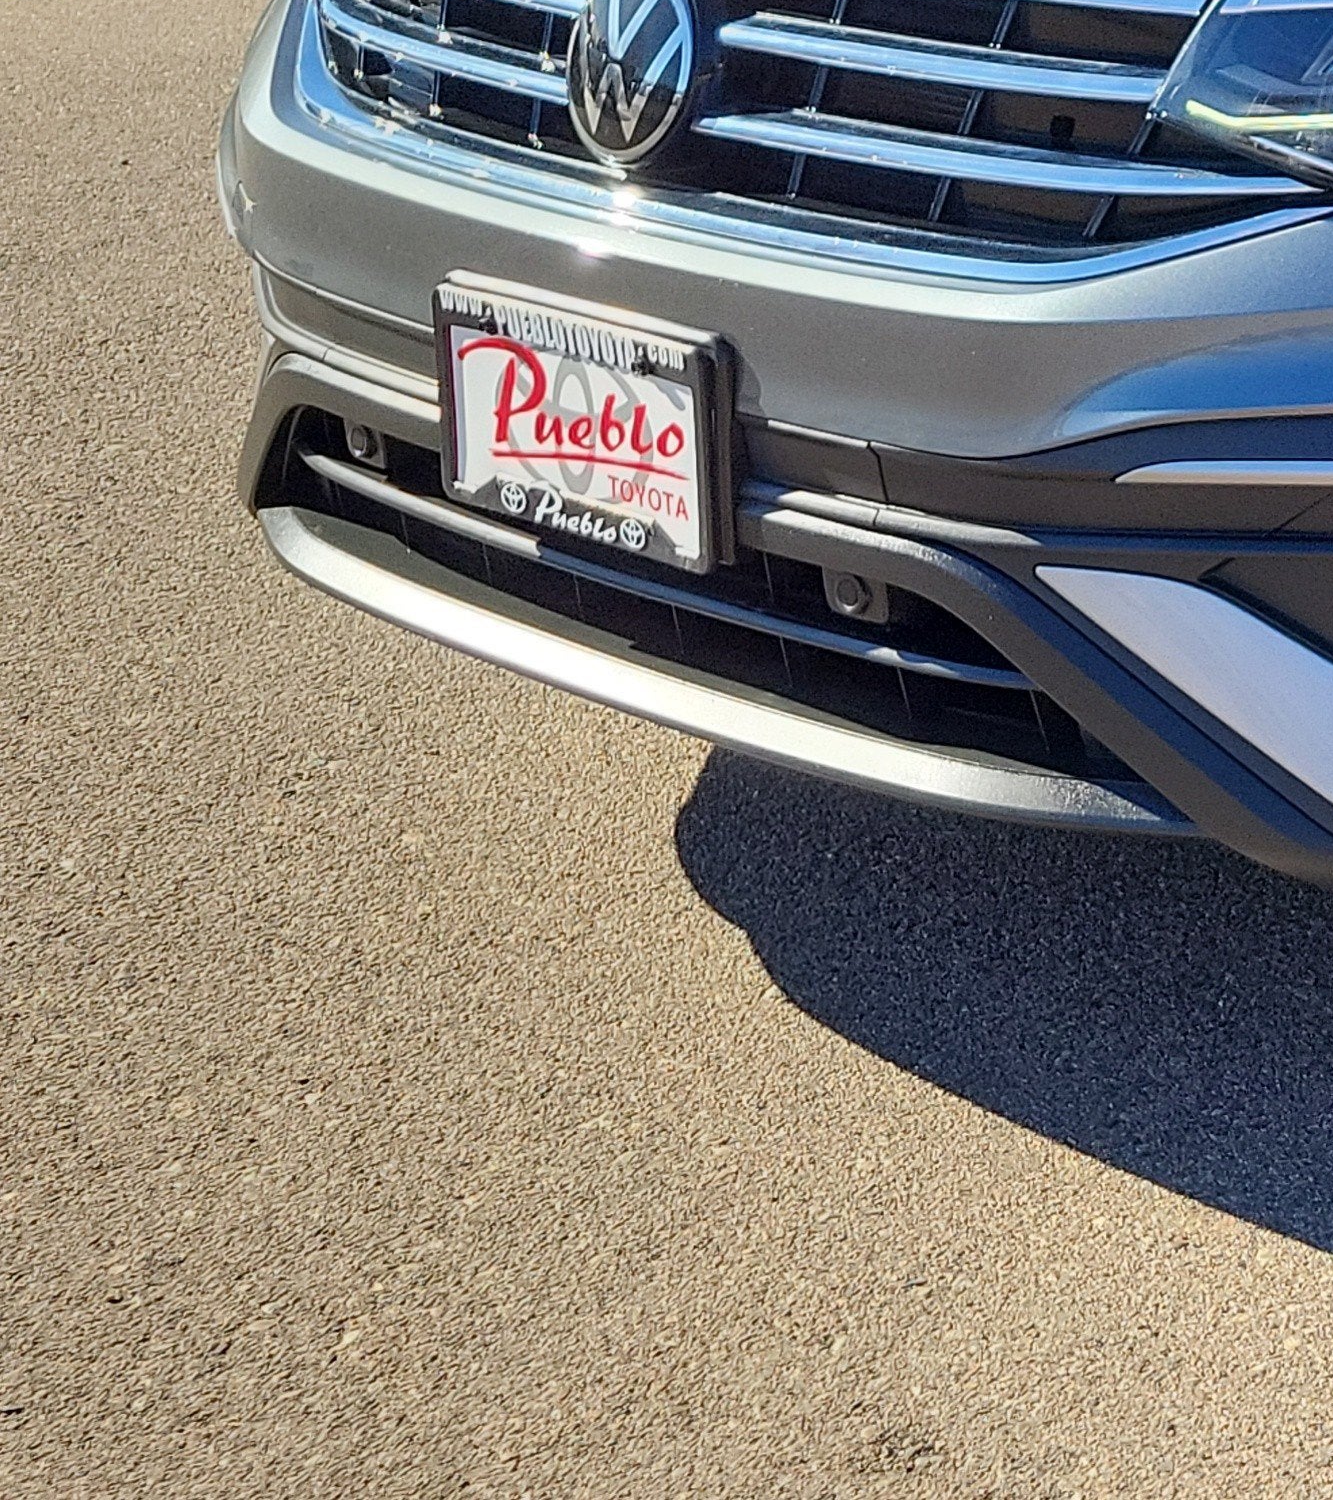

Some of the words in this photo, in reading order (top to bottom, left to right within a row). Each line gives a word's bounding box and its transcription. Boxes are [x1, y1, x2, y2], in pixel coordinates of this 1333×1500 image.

[457, 338, 685, 457] Pueblo
[528, 481, 618, 543] Pueblo
[607, 475, 690, 521] TOYOTA
